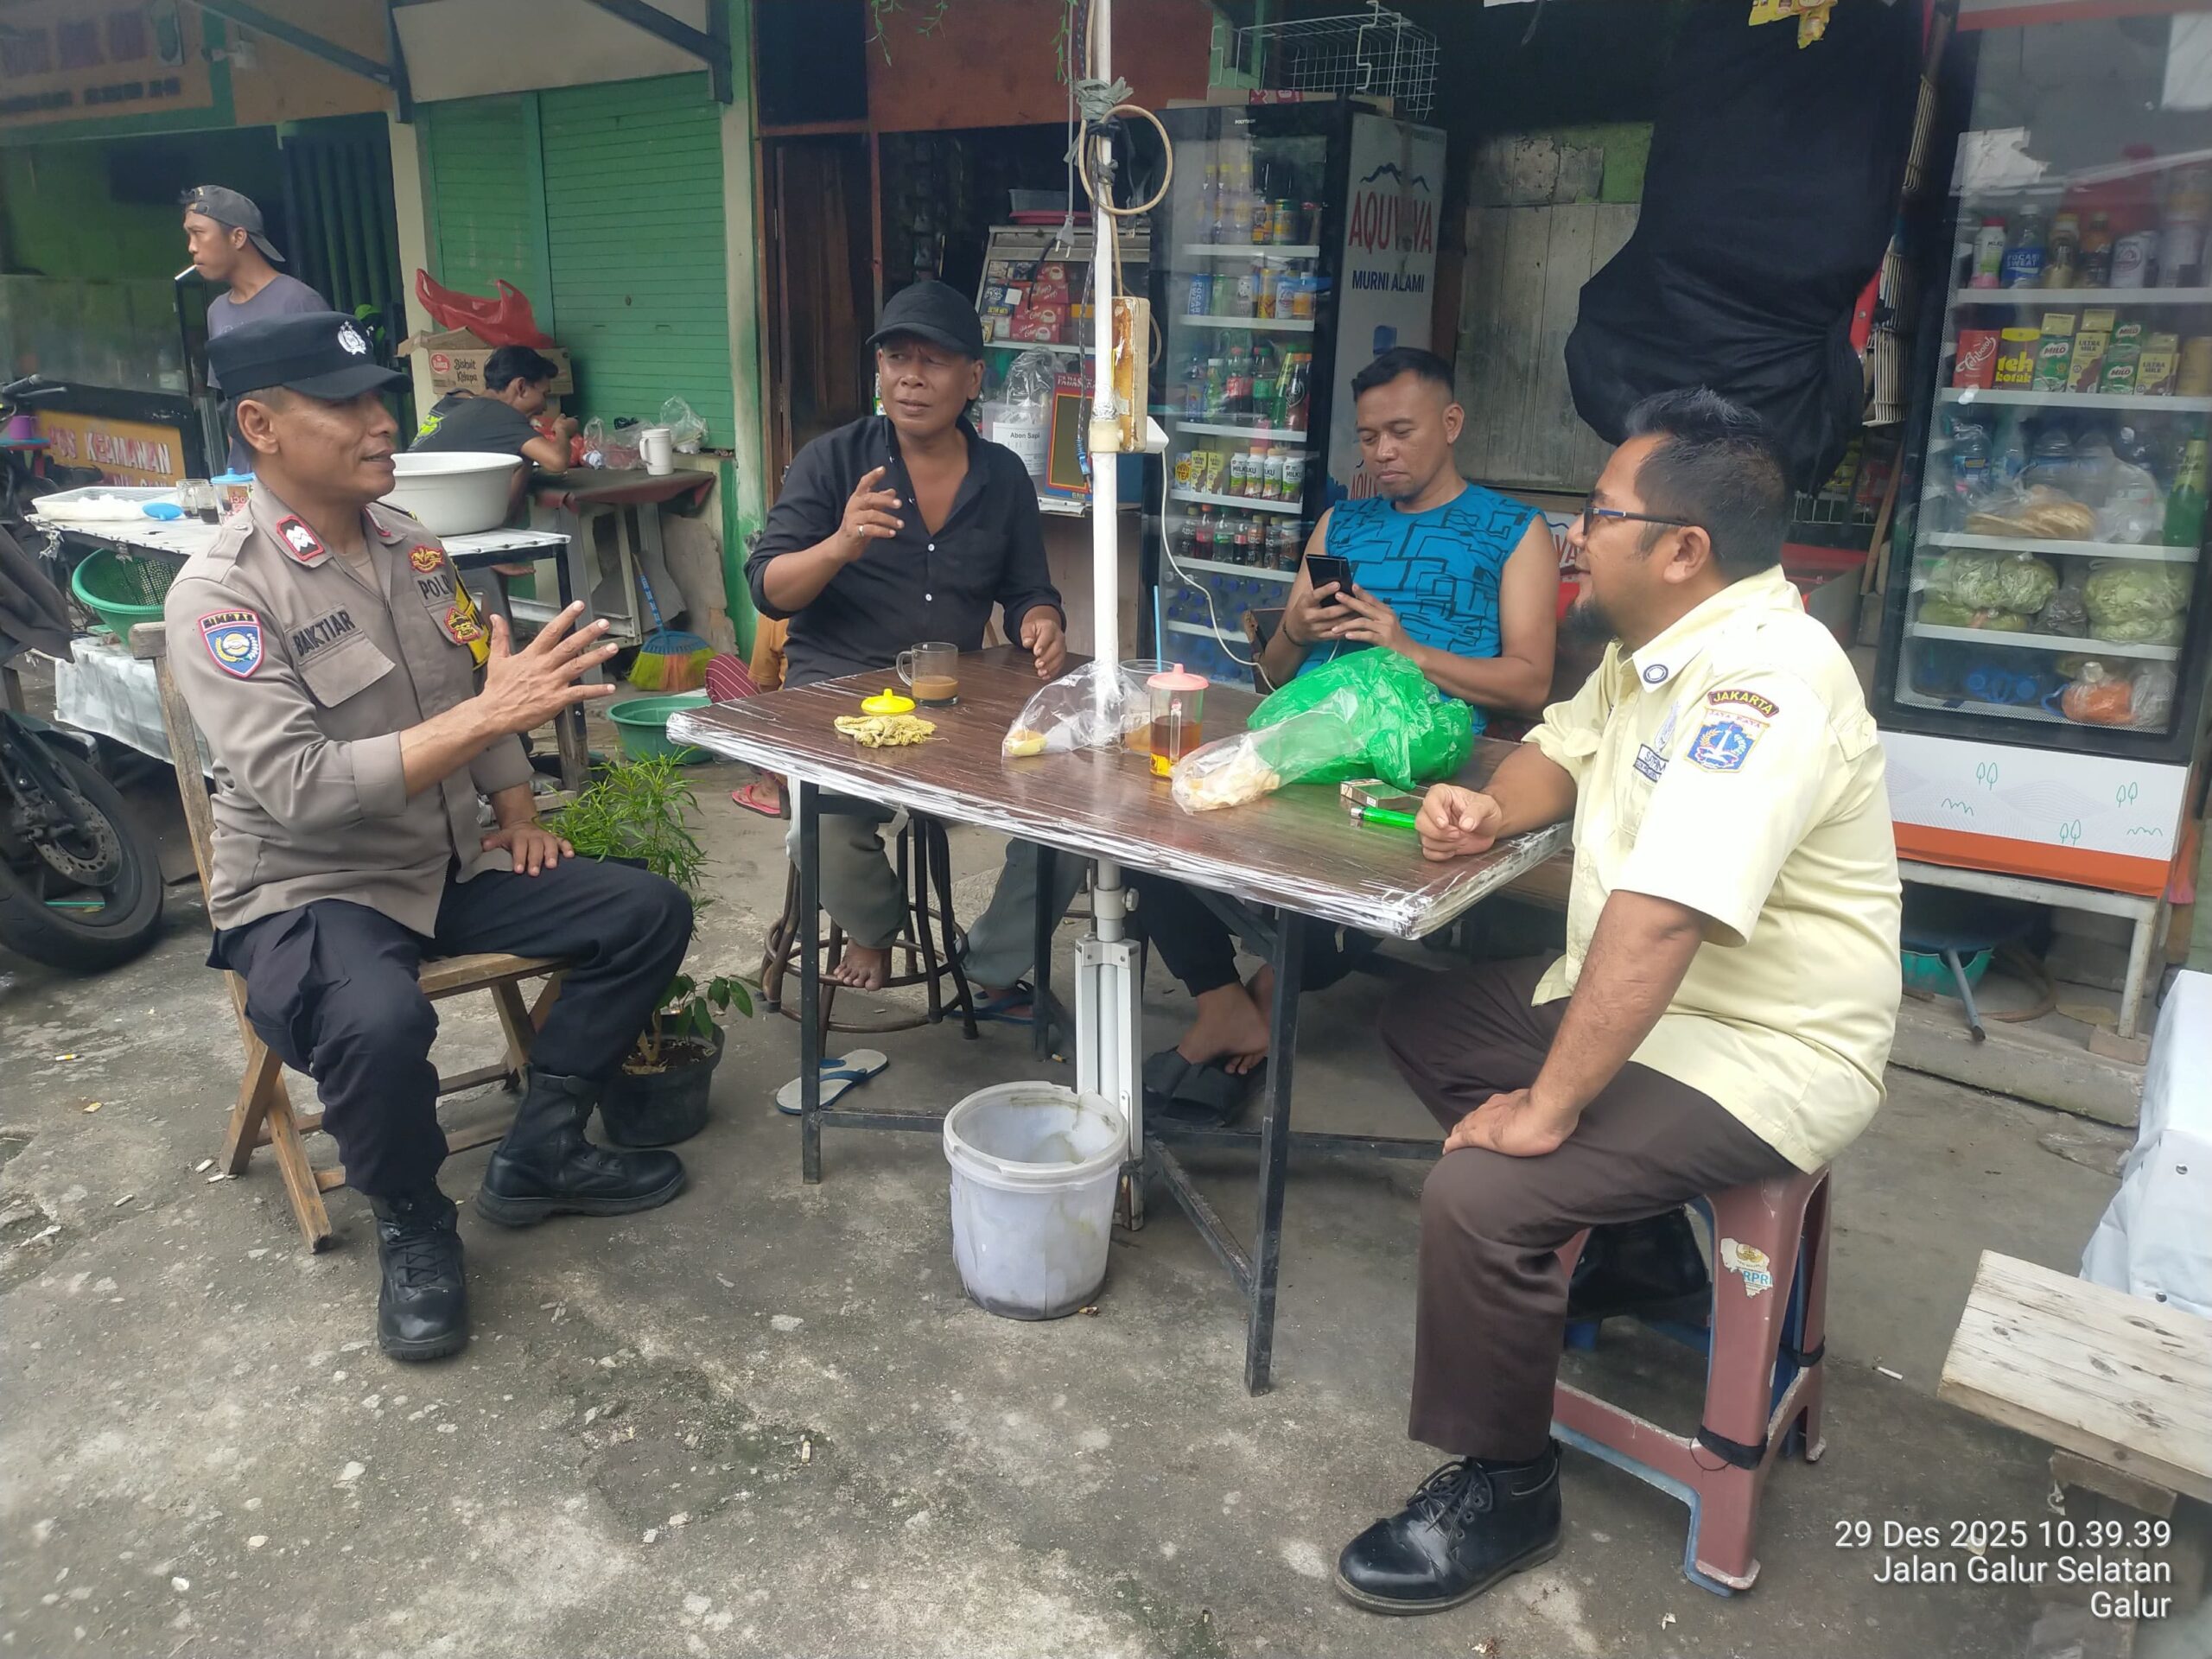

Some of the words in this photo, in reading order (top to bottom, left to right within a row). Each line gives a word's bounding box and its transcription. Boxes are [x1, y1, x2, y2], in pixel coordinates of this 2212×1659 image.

[1352, 270, 1389, 291] MURNI
[1998, 351, 2034, 372] teh
[2044, 346, 2066, 355] MILO
[85, 431, 172, 474] KEAMANAN
[293, 609, 356, 657] BAKTIAR
[1713, 691, 1773, 715] JAKARTA
